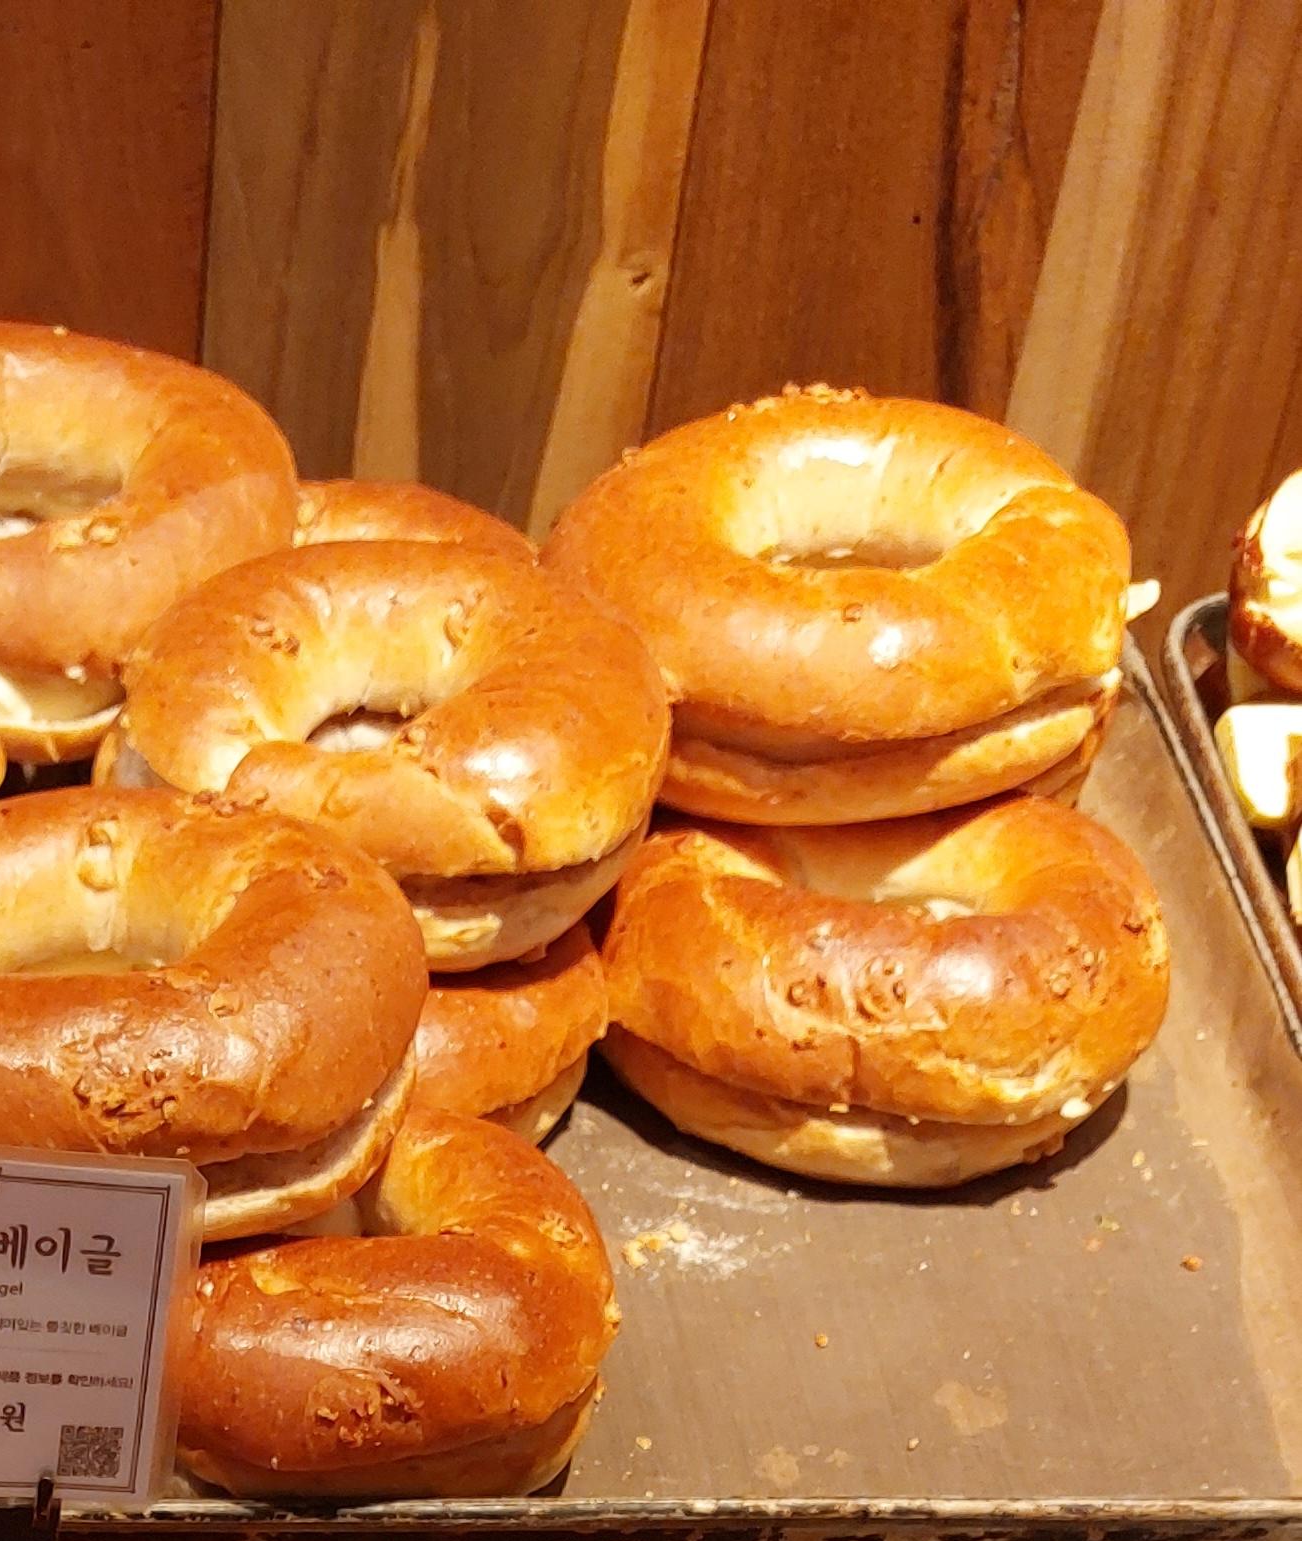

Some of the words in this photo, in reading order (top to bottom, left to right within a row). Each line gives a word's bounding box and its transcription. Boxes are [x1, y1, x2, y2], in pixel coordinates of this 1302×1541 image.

[89, 1324, 128, 1338] 베이글
[25, 1371, 63, 1385] 정보를
[67, 1373, 134, 1390] 확인하세요!
